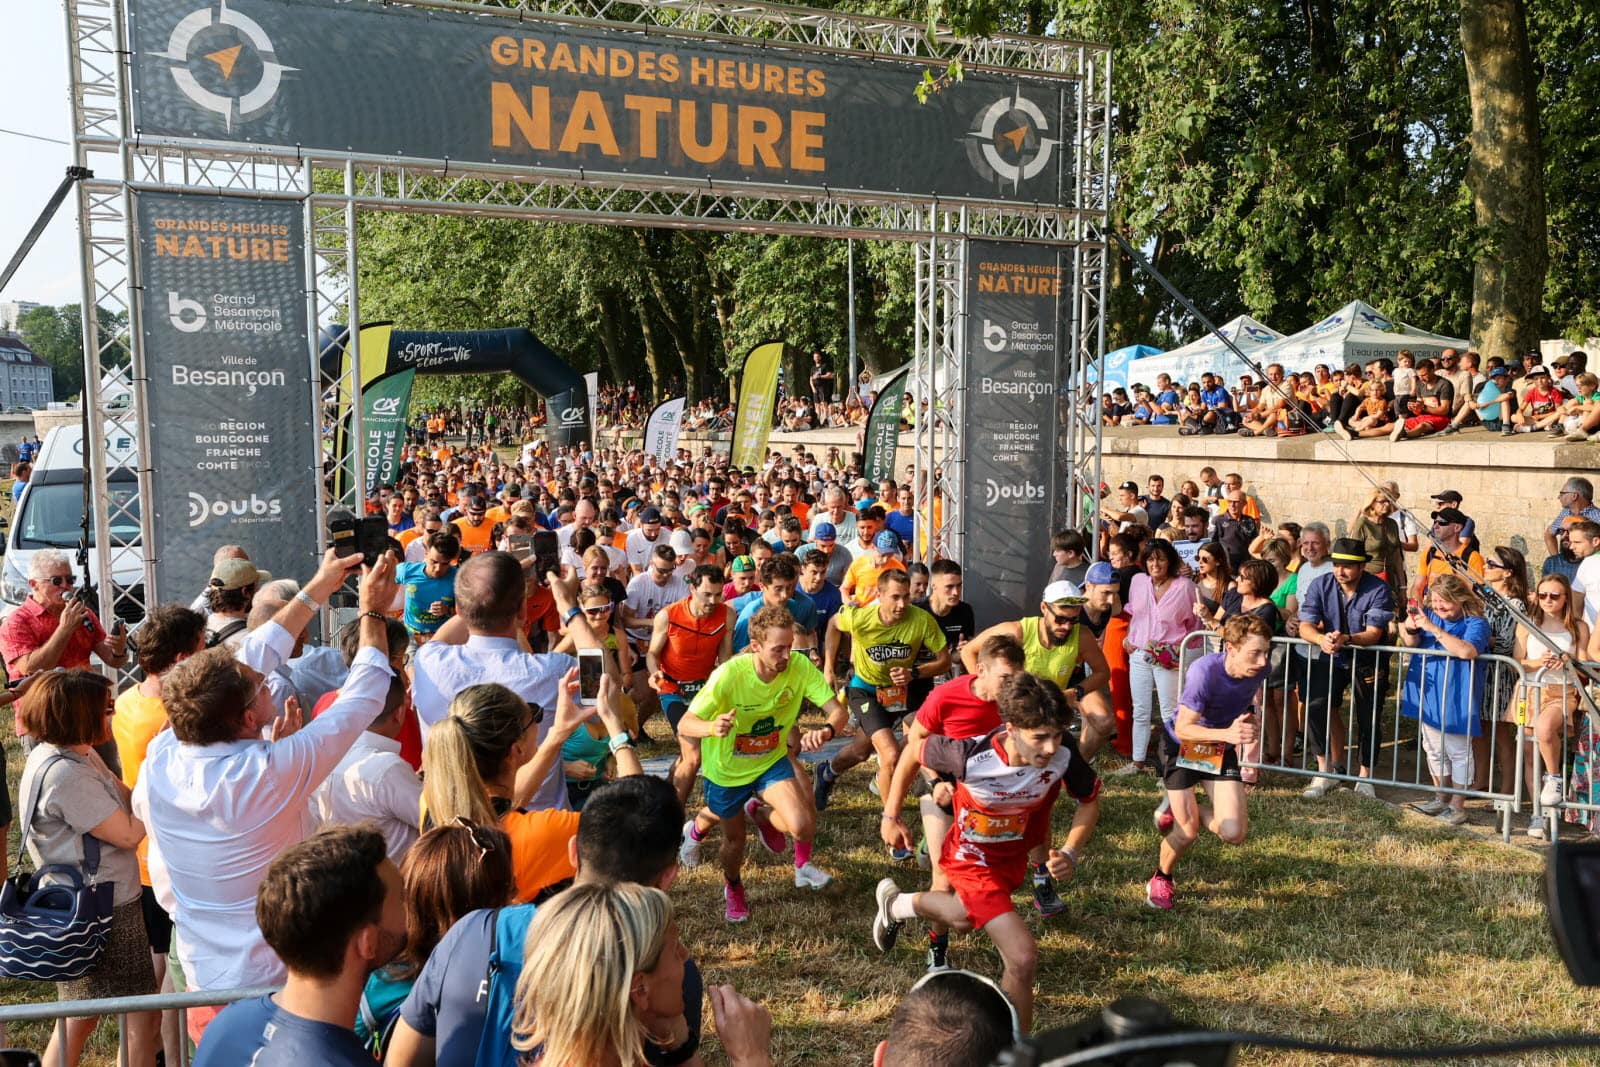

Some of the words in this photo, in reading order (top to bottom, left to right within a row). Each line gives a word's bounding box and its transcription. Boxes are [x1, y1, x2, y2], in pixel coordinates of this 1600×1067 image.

[491, 36, 681, 83] GRANDES
[691, 57, 827, 98] HEURES
[491, 82, 826, 172] NATURE
[155, 218, 228, 233] GRANDES
[231, 222, 289, 236] HEURES
[155, 233, 289, 262] NATURE
[979, 262, 1025, 273] GRANDES
[1027, 265, 1063, 275] HEURES
[978, 274, 1062, 296] NATURE
[213, 294, 256, 305] Grand
[213, 306, 281, 321] Besançon
[214, 319, 283, 334] Métropole
[1011, 321, 1039, 330] Grand
[1011, 331, 1054, 343] Besançon
[404, 342, 443, 362] SPORT
[453, 345, 472, 362] VIE
[1011, 342, 1054, 352] Métropole
[1373, 347, 1384, 357] de
[221, 356, 244, 365] Ville
[245, 356, 257, 365] de
[172, 365, 286, 397] Besançon
[1013, 370, 1028, 378] Ville
[1028, 369, 1037, 378] de
[982, 378, 1053, 404] Besançon
[195, 434, 270, 444] BOURGOGNE
[206, 448, 261, 457] FRANCHE
[872, 422, 886, 484] AGRICOLE
[366, 430, 382, 499] AGRICOLE
[986, 478, 1045, 507] Doubs
[188, 491, 281, 527] Doubs
